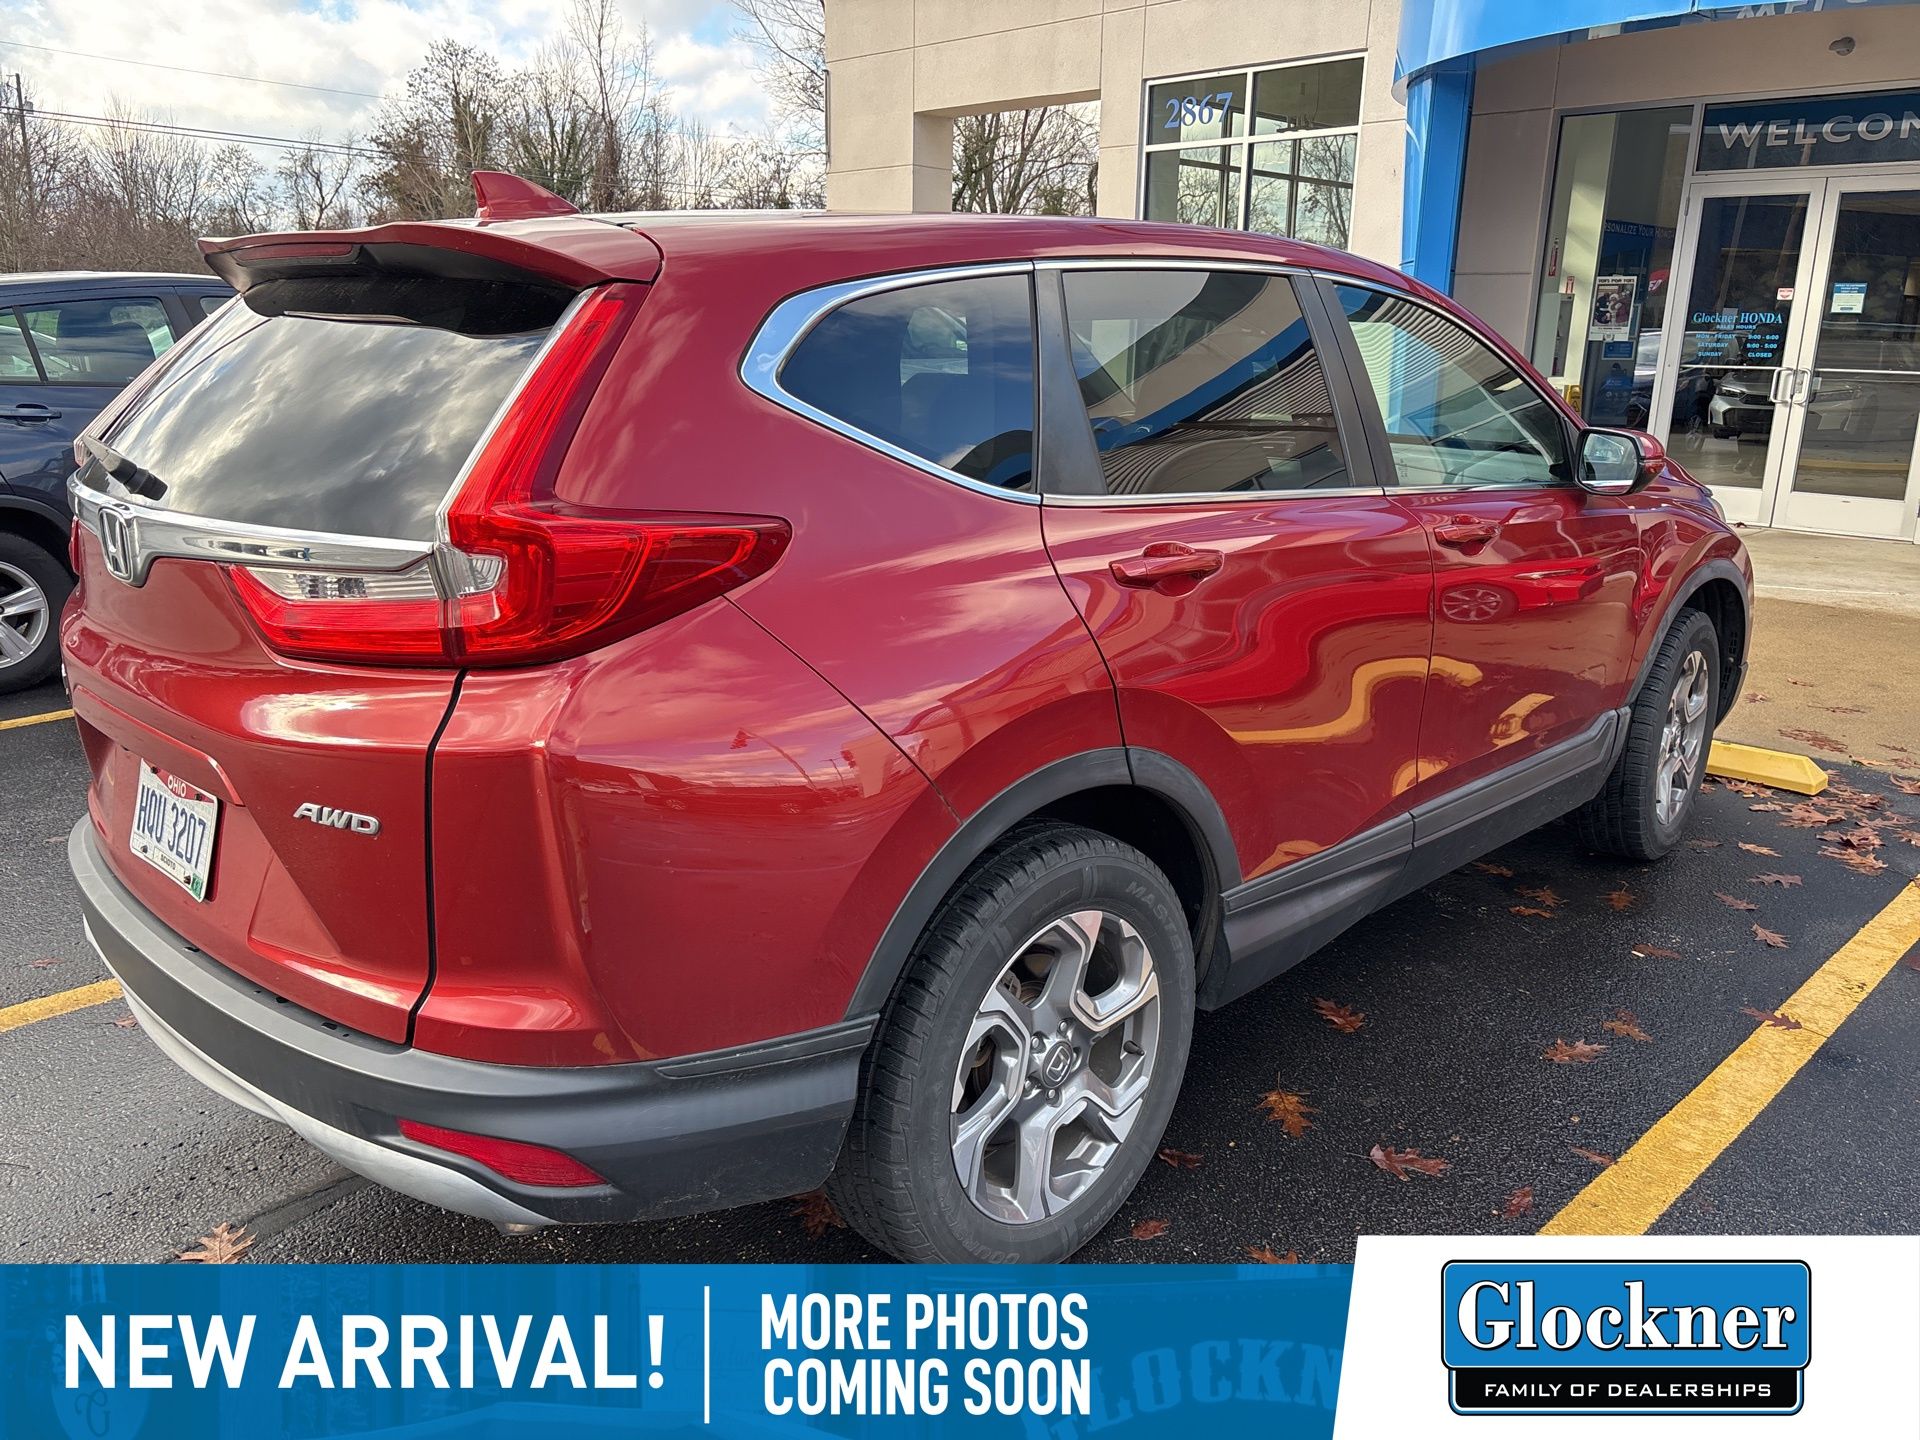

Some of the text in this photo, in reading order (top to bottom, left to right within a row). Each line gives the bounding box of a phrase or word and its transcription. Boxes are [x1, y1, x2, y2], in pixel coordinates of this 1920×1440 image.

[1164, 91, 1233, 128] 2867
[1693, 312, 1782, 324] Glockner HONDA
[167, 774, 187, 798] OHIO
[136, 783, 207, 870] HQU 3207
[293, 802, 381, 836] AWD
